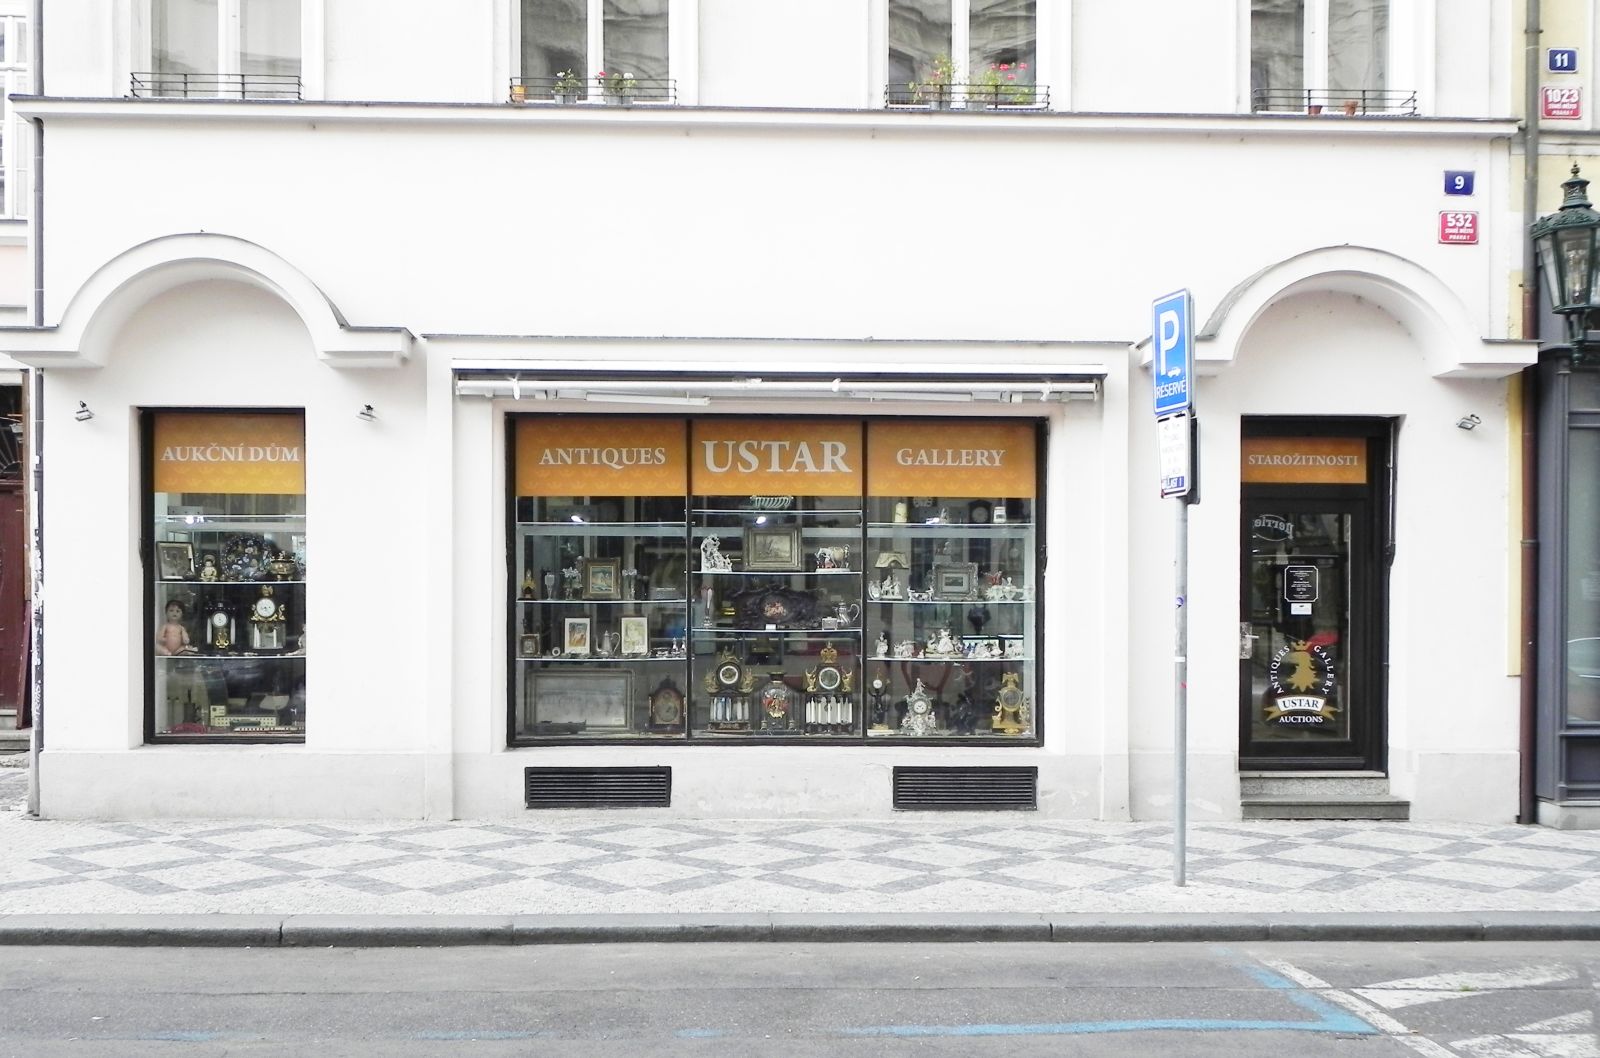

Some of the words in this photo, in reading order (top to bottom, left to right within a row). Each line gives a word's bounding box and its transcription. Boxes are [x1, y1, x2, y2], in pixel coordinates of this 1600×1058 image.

[1554, 53, 1569, 68] 11
[1546, 88, 1579, 103] 1023
[1454, 175, 1465, 190] 9
[1447, 213, 1473, 228] 532
[1160, 310, 1180, 376] P
[1156, 377, 1186, 398] RÉSERVÉ
[160, 442, 244, 462] AUKČNÍ
[249, 442, 300, 462] DŮM
[539, 447, 666, 470] ANTIQUES
[701, 440, 853, 473] USTAR
[896, 448, 1006, 467] GALLERY
[1248, 453, 1359, 466] STAROŽITNOSTI
[1270, 645, 1290, 694] ANTIQUES
[1314, 645, 1335, 694] GALLERY
[1282, 698, 1319, 709] USTAR
[1279, 715, 1324, 723] AUCTIONS
